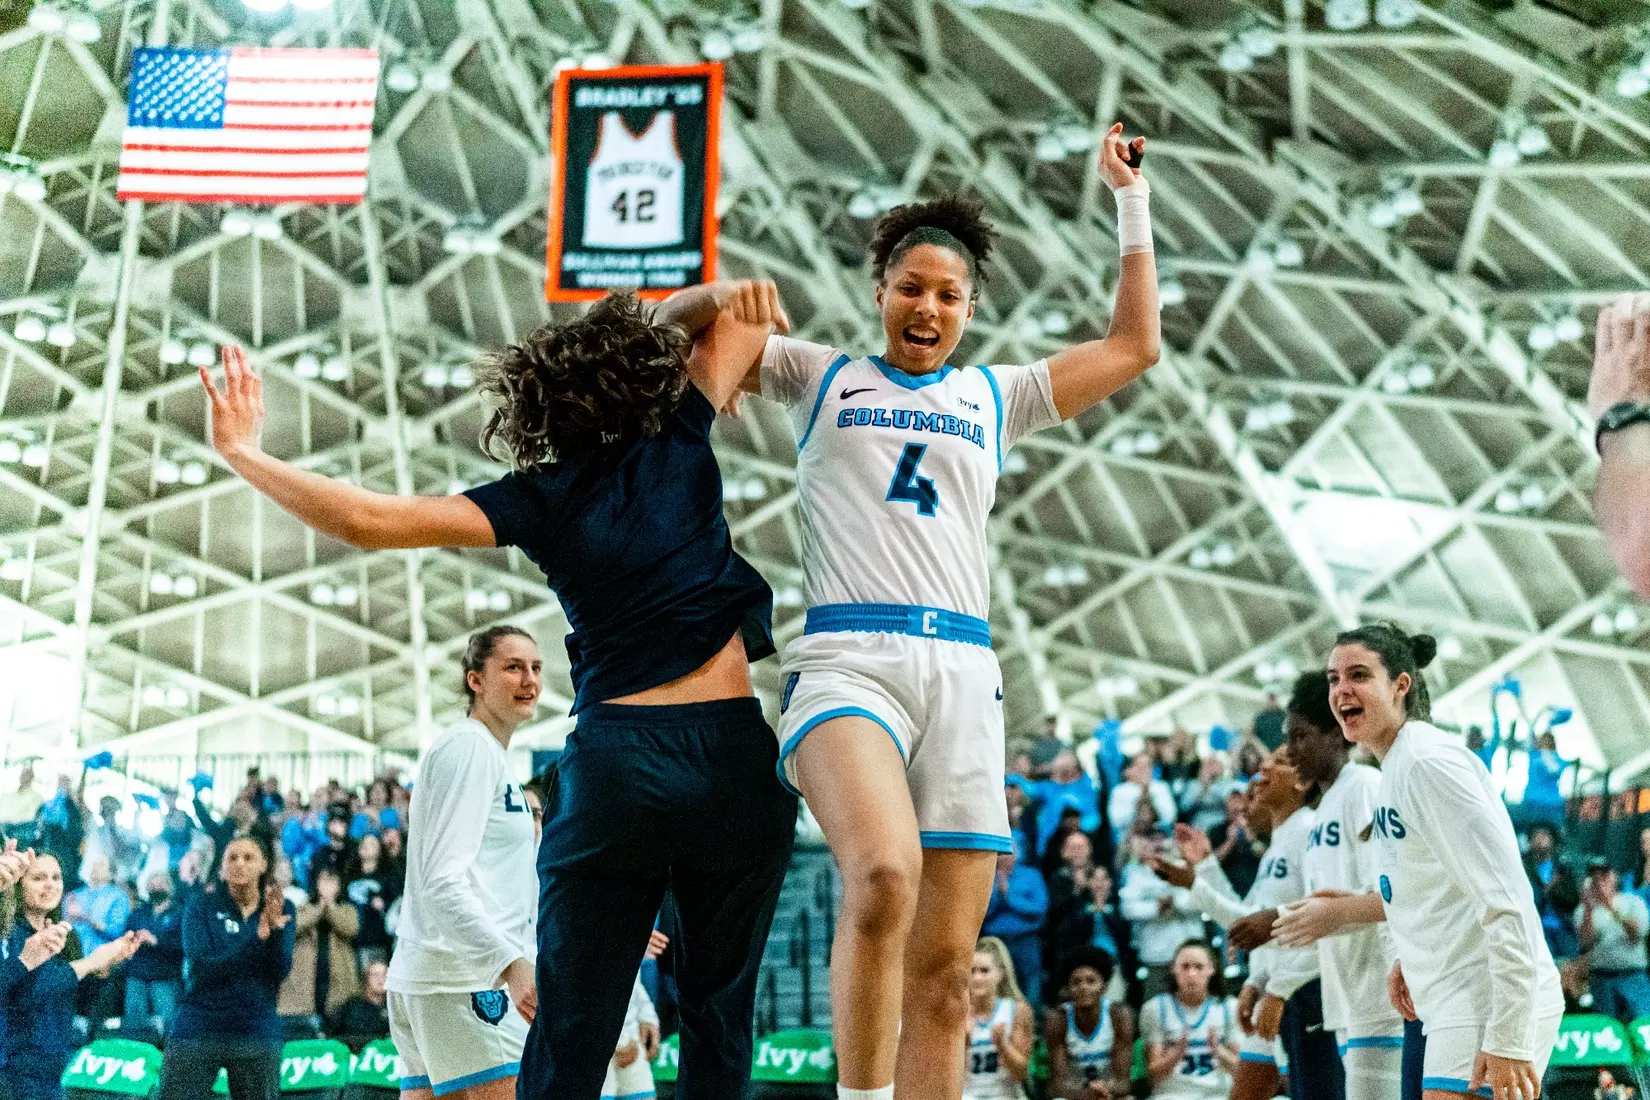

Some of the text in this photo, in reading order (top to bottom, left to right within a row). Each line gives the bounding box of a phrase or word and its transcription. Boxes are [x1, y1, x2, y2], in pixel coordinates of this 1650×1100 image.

[611, 189, 656, 223] 42
[600, 431, 619, 444] Iv
[837, 407, 985, 450] COLUMBIA
[885, 441, 939, 518] 4
[922, 611, 938, 635] C
[1373, 806, 1406, 839] NS
[69, 1048, 124, 1085] Ivy
[755, 1042, 808, 1075] Ivy
